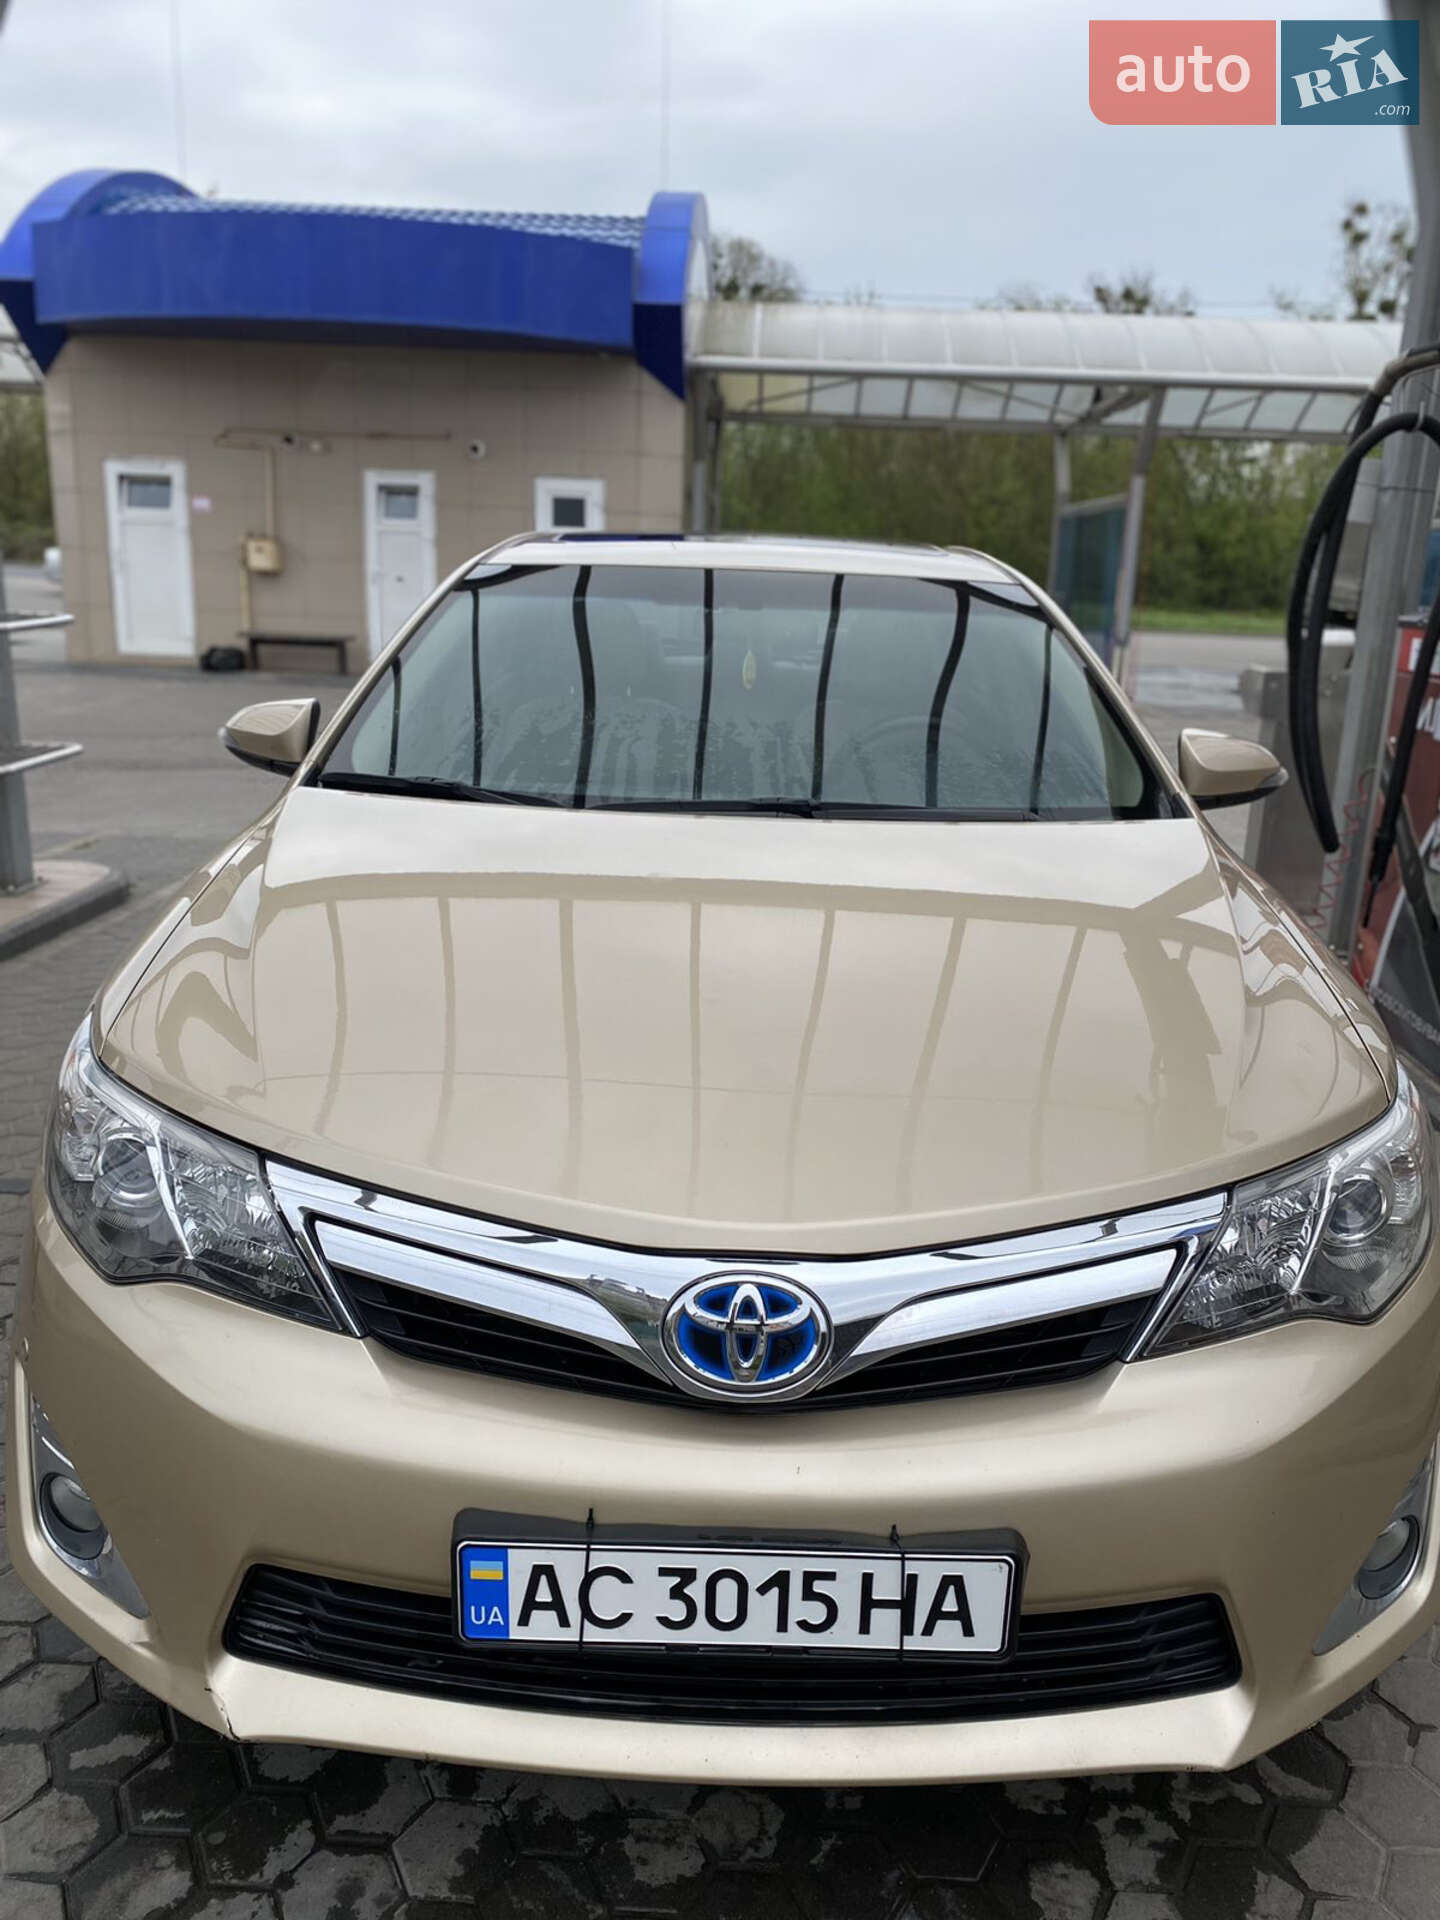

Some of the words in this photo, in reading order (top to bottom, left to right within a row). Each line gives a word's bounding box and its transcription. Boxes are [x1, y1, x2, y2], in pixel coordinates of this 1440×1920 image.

[470, 1605, 504, 1626] UA
[516, 1564, 634, 1629] AC
[655, 1566, 839, 1633] 3015
[858, 1571, 976, 1638] HA
